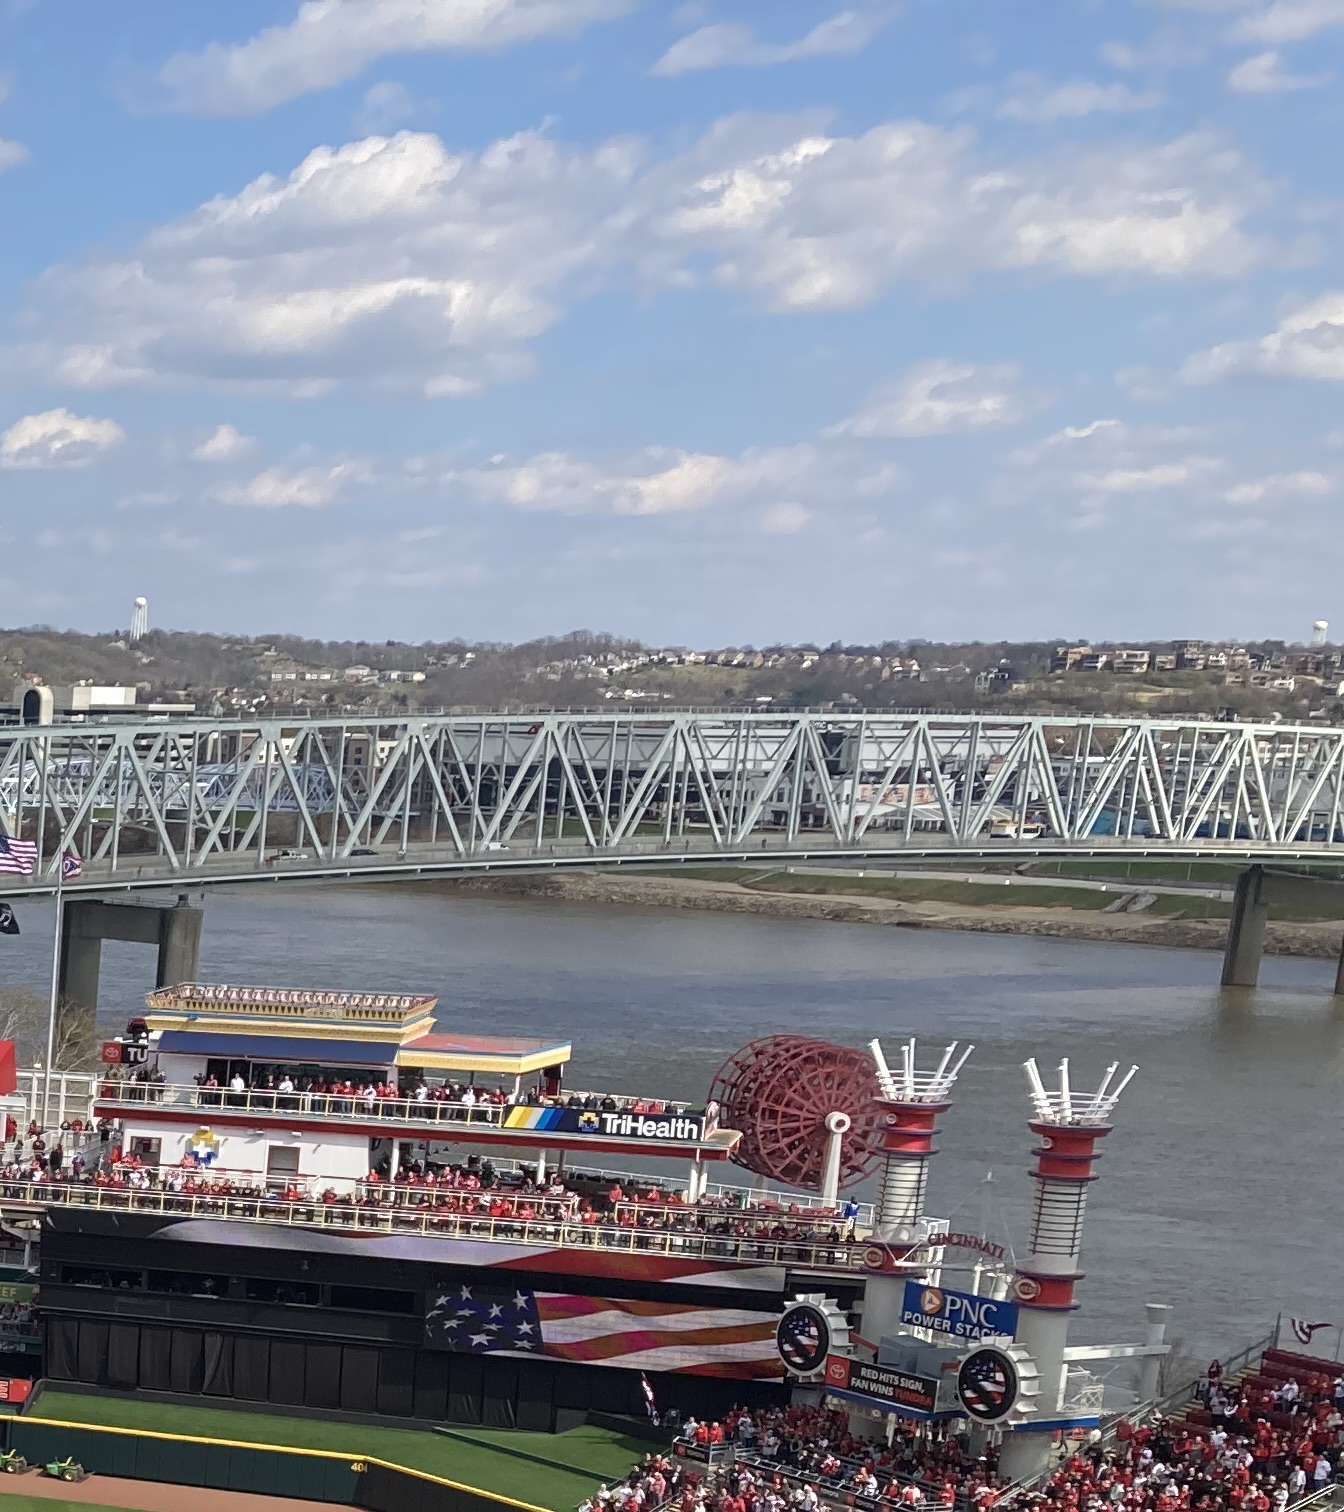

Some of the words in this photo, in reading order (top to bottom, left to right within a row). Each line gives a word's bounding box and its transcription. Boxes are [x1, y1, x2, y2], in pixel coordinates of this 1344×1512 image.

[602, 1113, 699, 1140] TriHealth
[927, 1233, 1005, 1259] CINCINNATI
[903, 1311, 951, 1332] POWER
[944, 1294, 998, 1328] PNC
[851, 1377, 869, 1390] FAN
[870, 1382, 893, 1396] WINS
[860, 1367, 879, 1380] RED
[879, 1373, 900, 1386] HITS
[900, 1378, 925, 1393] SIGN,
